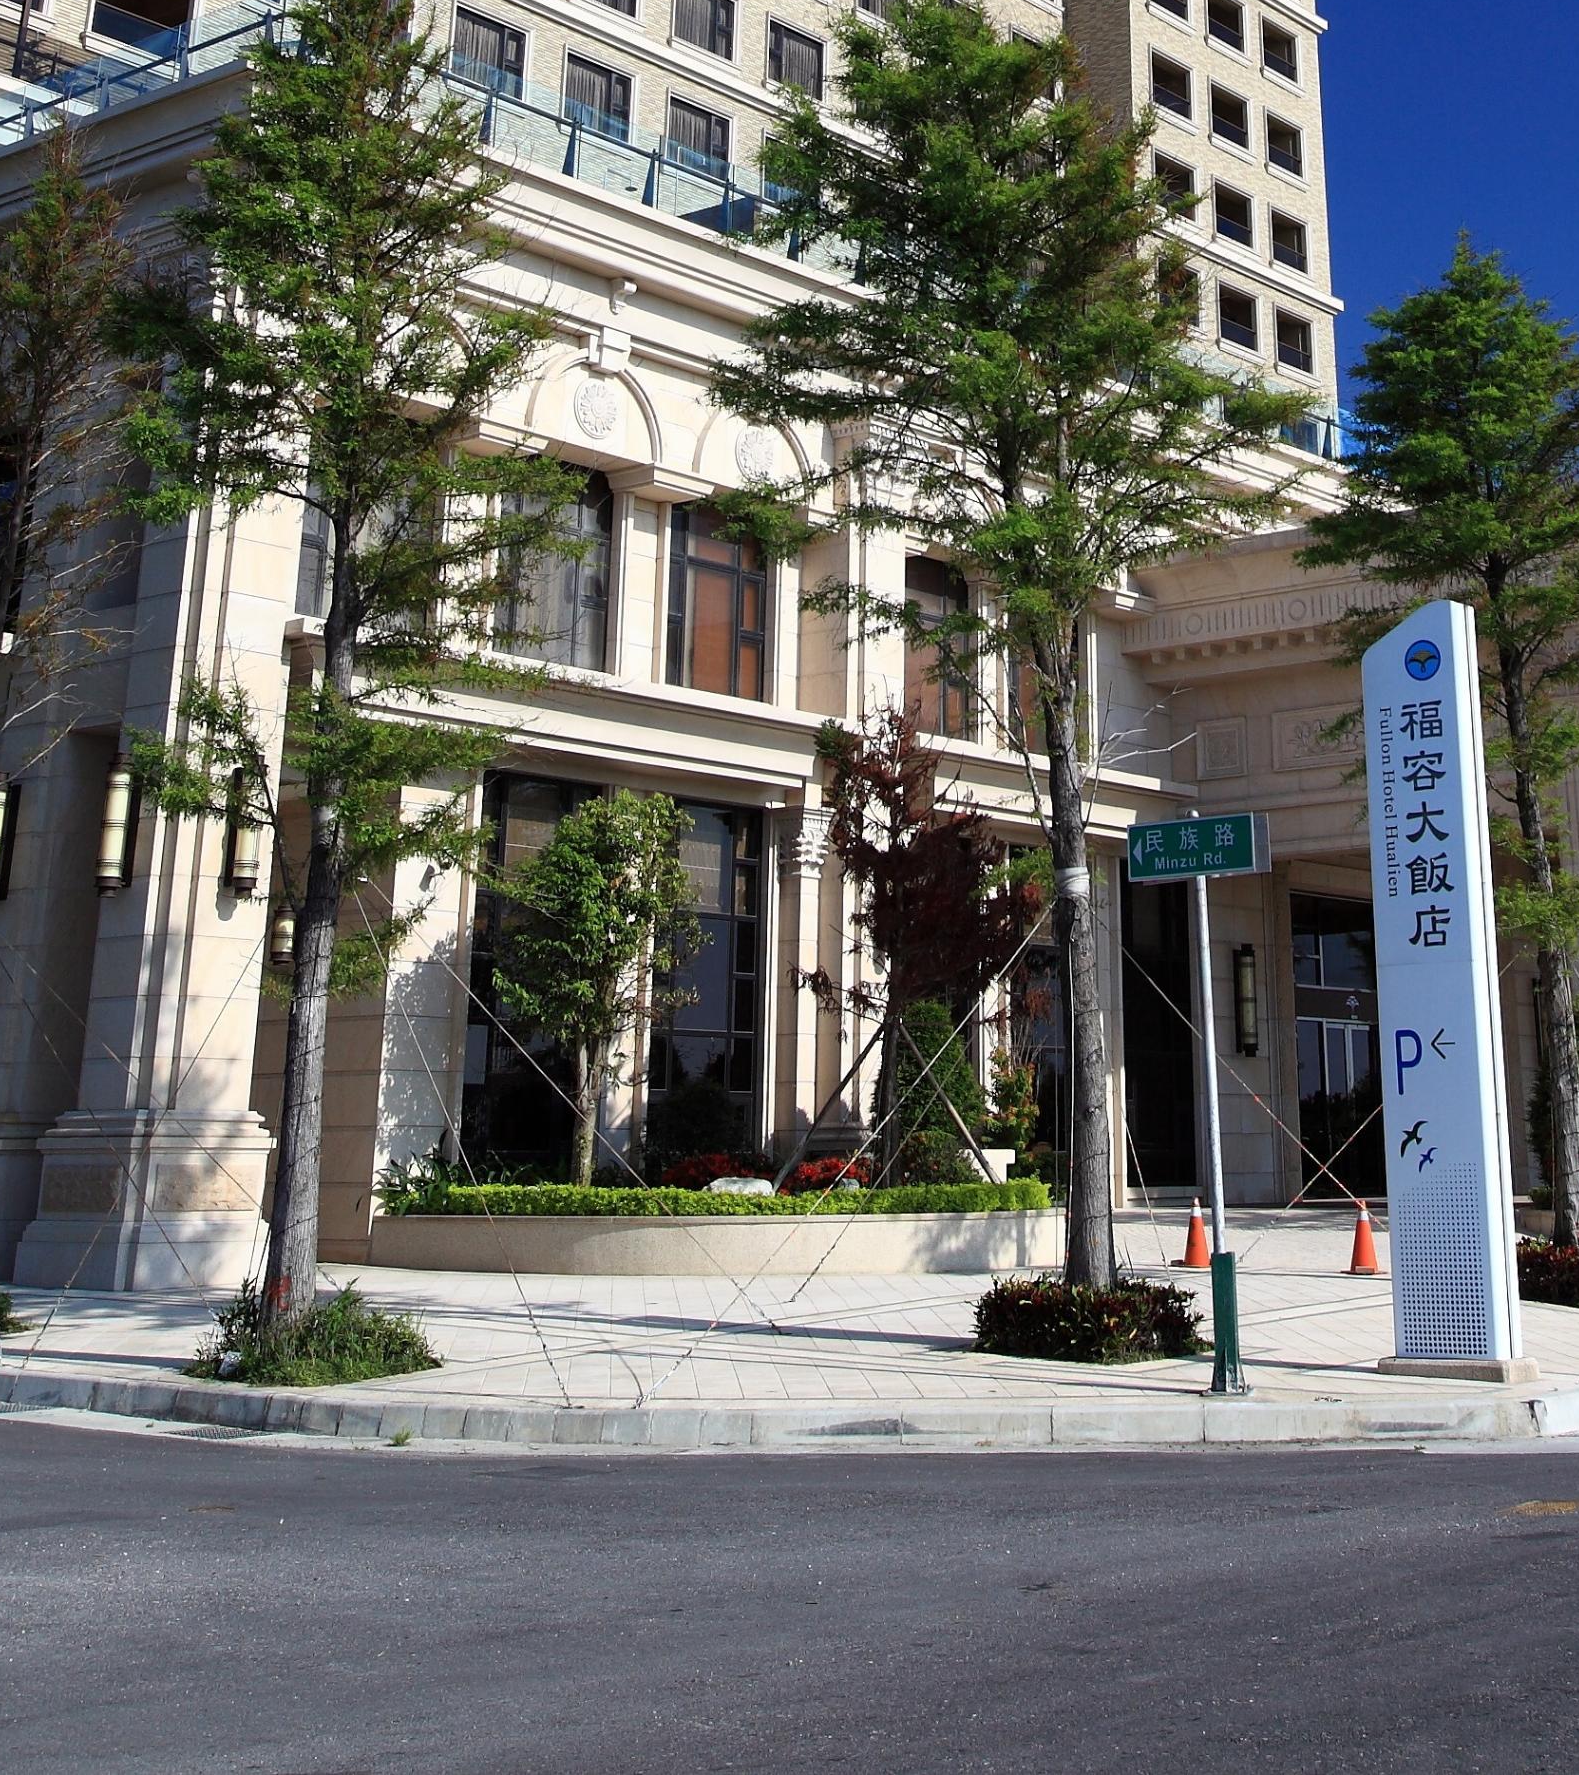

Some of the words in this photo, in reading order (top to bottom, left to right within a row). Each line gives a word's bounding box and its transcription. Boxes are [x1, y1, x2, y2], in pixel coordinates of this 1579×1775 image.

[1379, 706, 1393, 766] Fullon
[1382, 770, 1397, 822] Hotel
[1399, 699, 1455, 948] 福容大飯店
[1145, 823, 1235, 853] 民族路
[1155, 856, 1197, 871] Minzu
[1203, 852, 1226, 866] Rd.
[1385, 825, 1401, 898] Hualien
[1395, 1029, 1423, 1096] P
